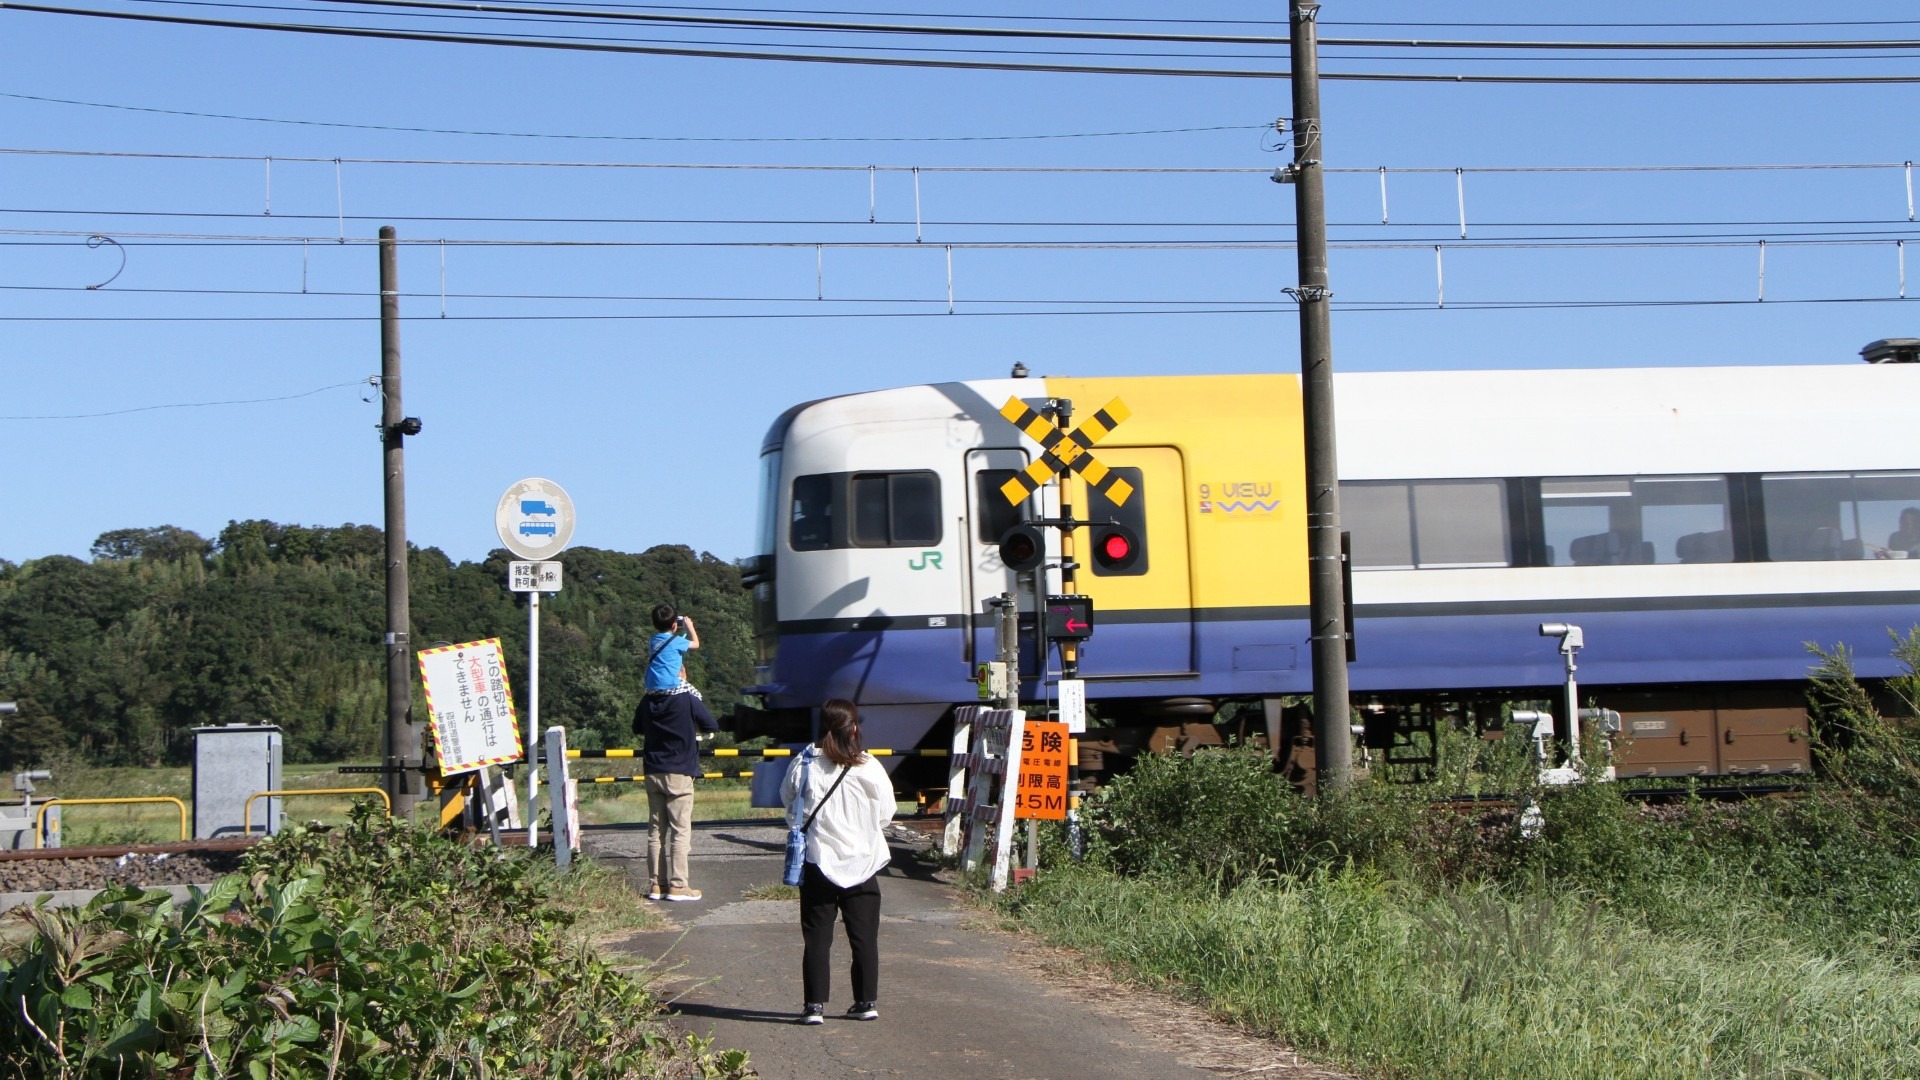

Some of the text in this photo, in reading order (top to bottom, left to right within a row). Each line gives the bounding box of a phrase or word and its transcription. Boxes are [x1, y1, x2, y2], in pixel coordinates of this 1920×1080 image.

[1200, 483, 1210, 499] 9
[1222, 482, 1272, 498] VIEW
[909, 551, 943, 570] JR
[452, 656, 476, 724] できません
[486, 652, 509, 718] この踏切は
[1022, 730, 1063, 753] 危険
[1023, 757, 1062, 767] 電圧電線
